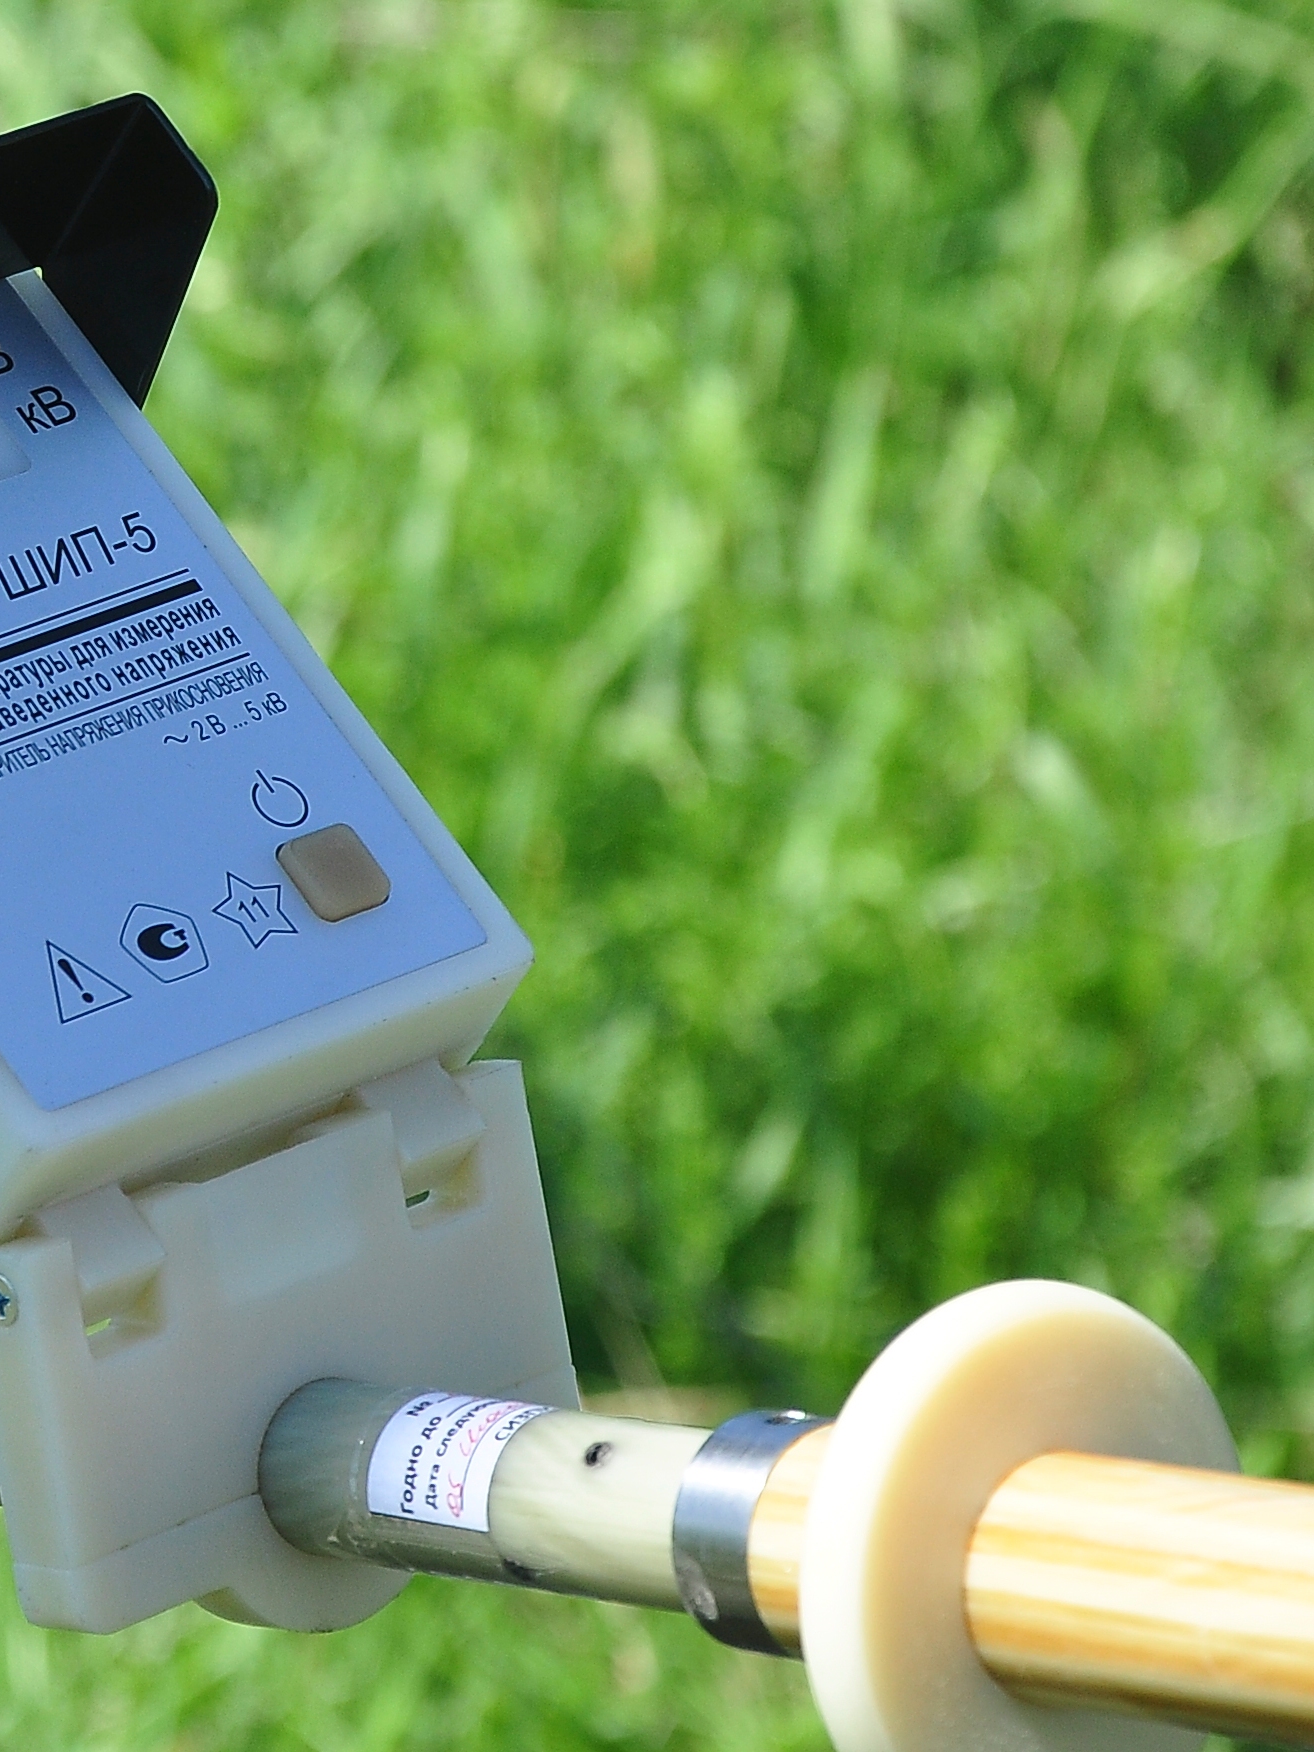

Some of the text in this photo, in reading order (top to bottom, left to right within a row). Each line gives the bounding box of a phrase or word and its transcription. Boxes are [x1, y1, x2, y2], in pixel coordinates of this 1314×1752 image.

[16, 384, 77, 434] кВ
[69, 636, 113, 671] для
[108, 597, 221, 652] измерения
[110, 626, 242, 688] напряжения
[45, 705, 150, 758] НАПРЯЖЕНИЯ
[141, 661, 270, 722] ПРИКОСНОВЕНИЯ
[261, 692, 288, 717] кВ
[238, 896, 270, 923] 11
[400, 1415, 442, 1515] Годно до
[424, 1463, 441, 1510] Дата
